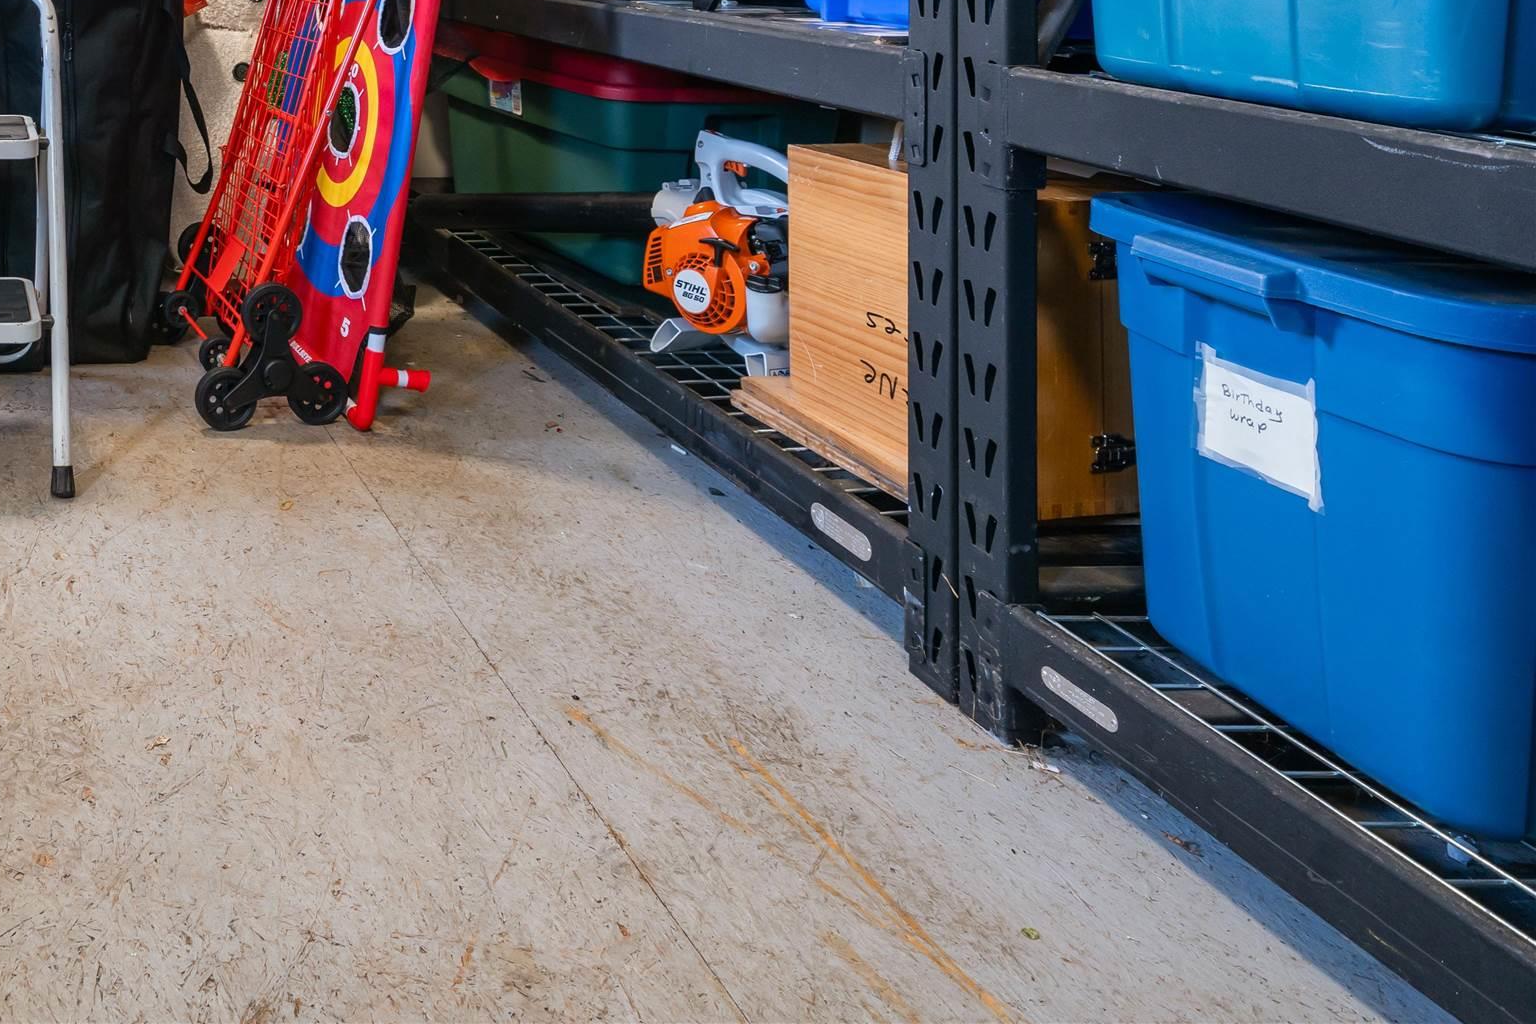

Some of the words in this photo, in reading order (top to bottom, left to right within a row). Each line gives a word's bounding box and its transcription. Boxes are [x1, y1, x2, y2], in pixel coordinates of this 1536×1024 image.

[675, 279, 707, 296] STIHL
[682, 291, 694, 300] BG
[693, 294, 705, 304] 50
[340, 316, 351, 337] 5
